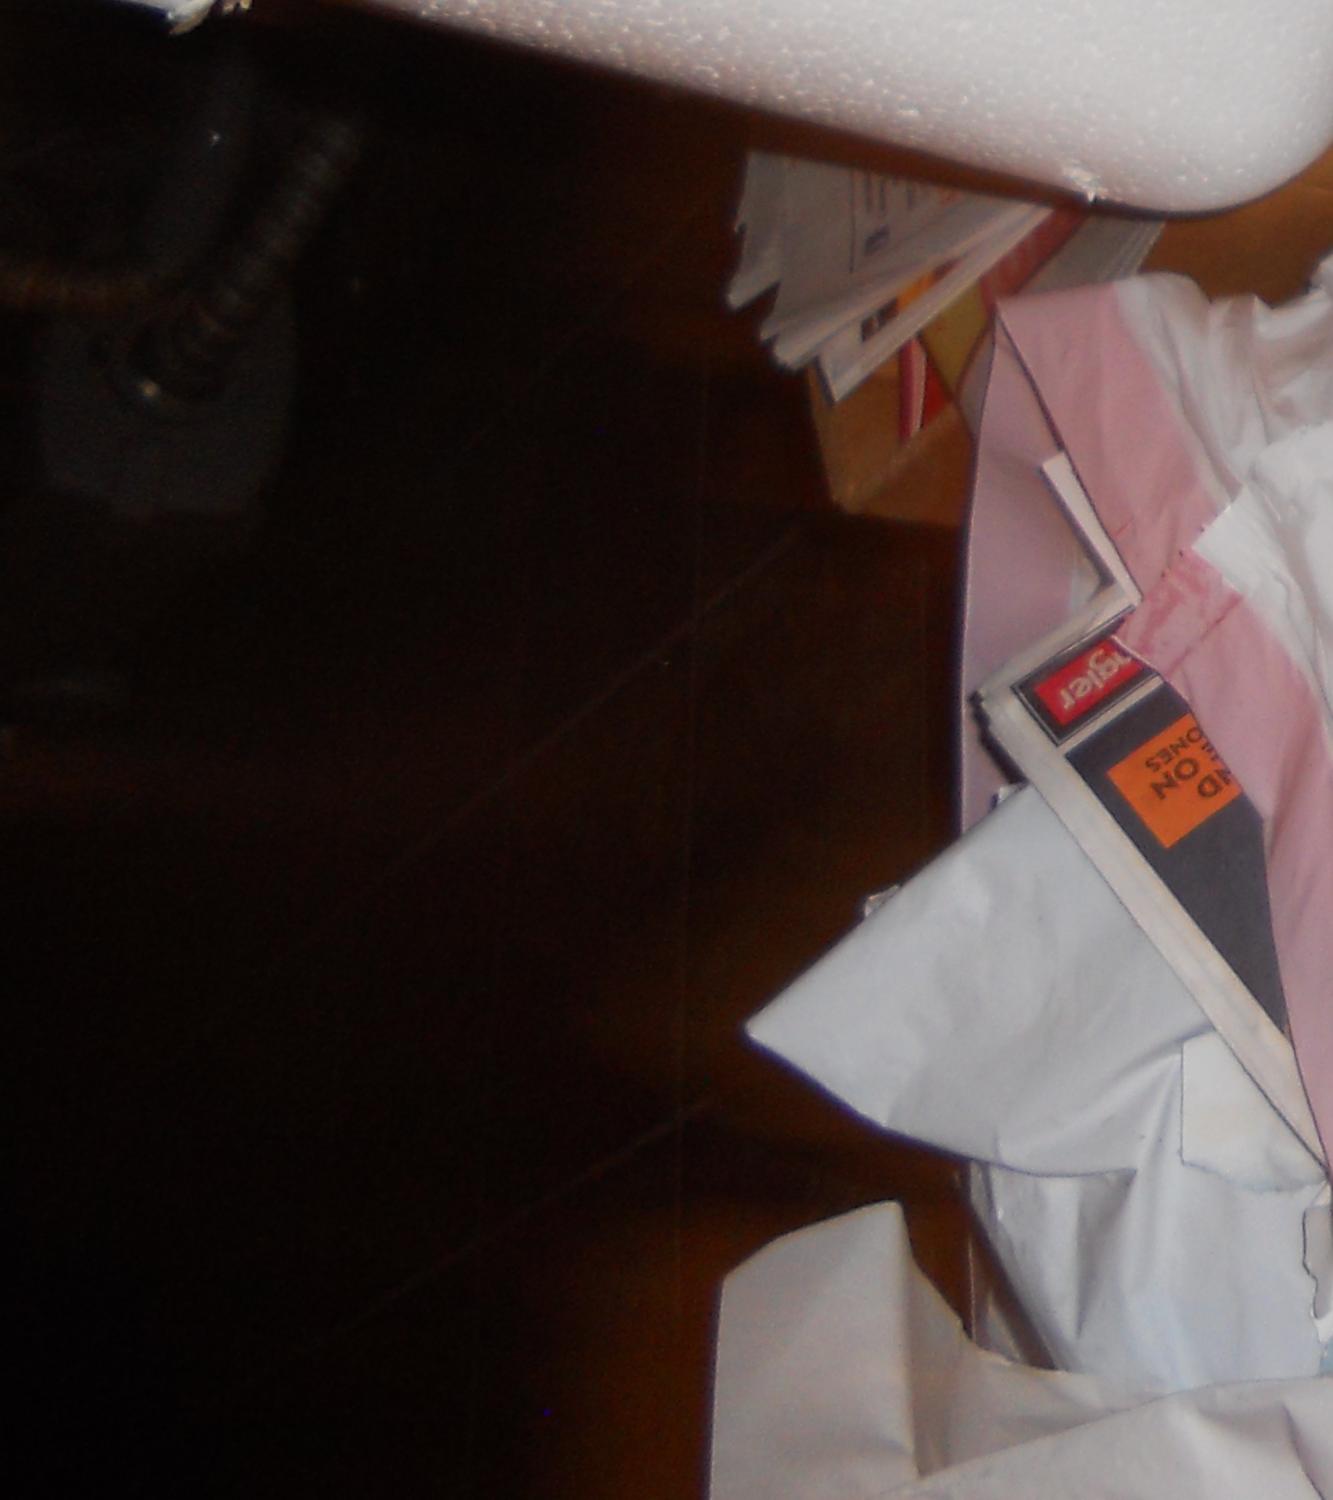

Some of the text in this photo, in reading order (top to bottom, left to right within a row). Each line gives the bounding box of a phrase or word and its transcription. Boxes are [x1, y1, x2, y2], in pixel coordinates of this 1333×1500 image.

[1060, 649, 1132, 710] ngler
[1144, 727, 1205, 773] ONES
[1150, 757, 1200, 800] ON
